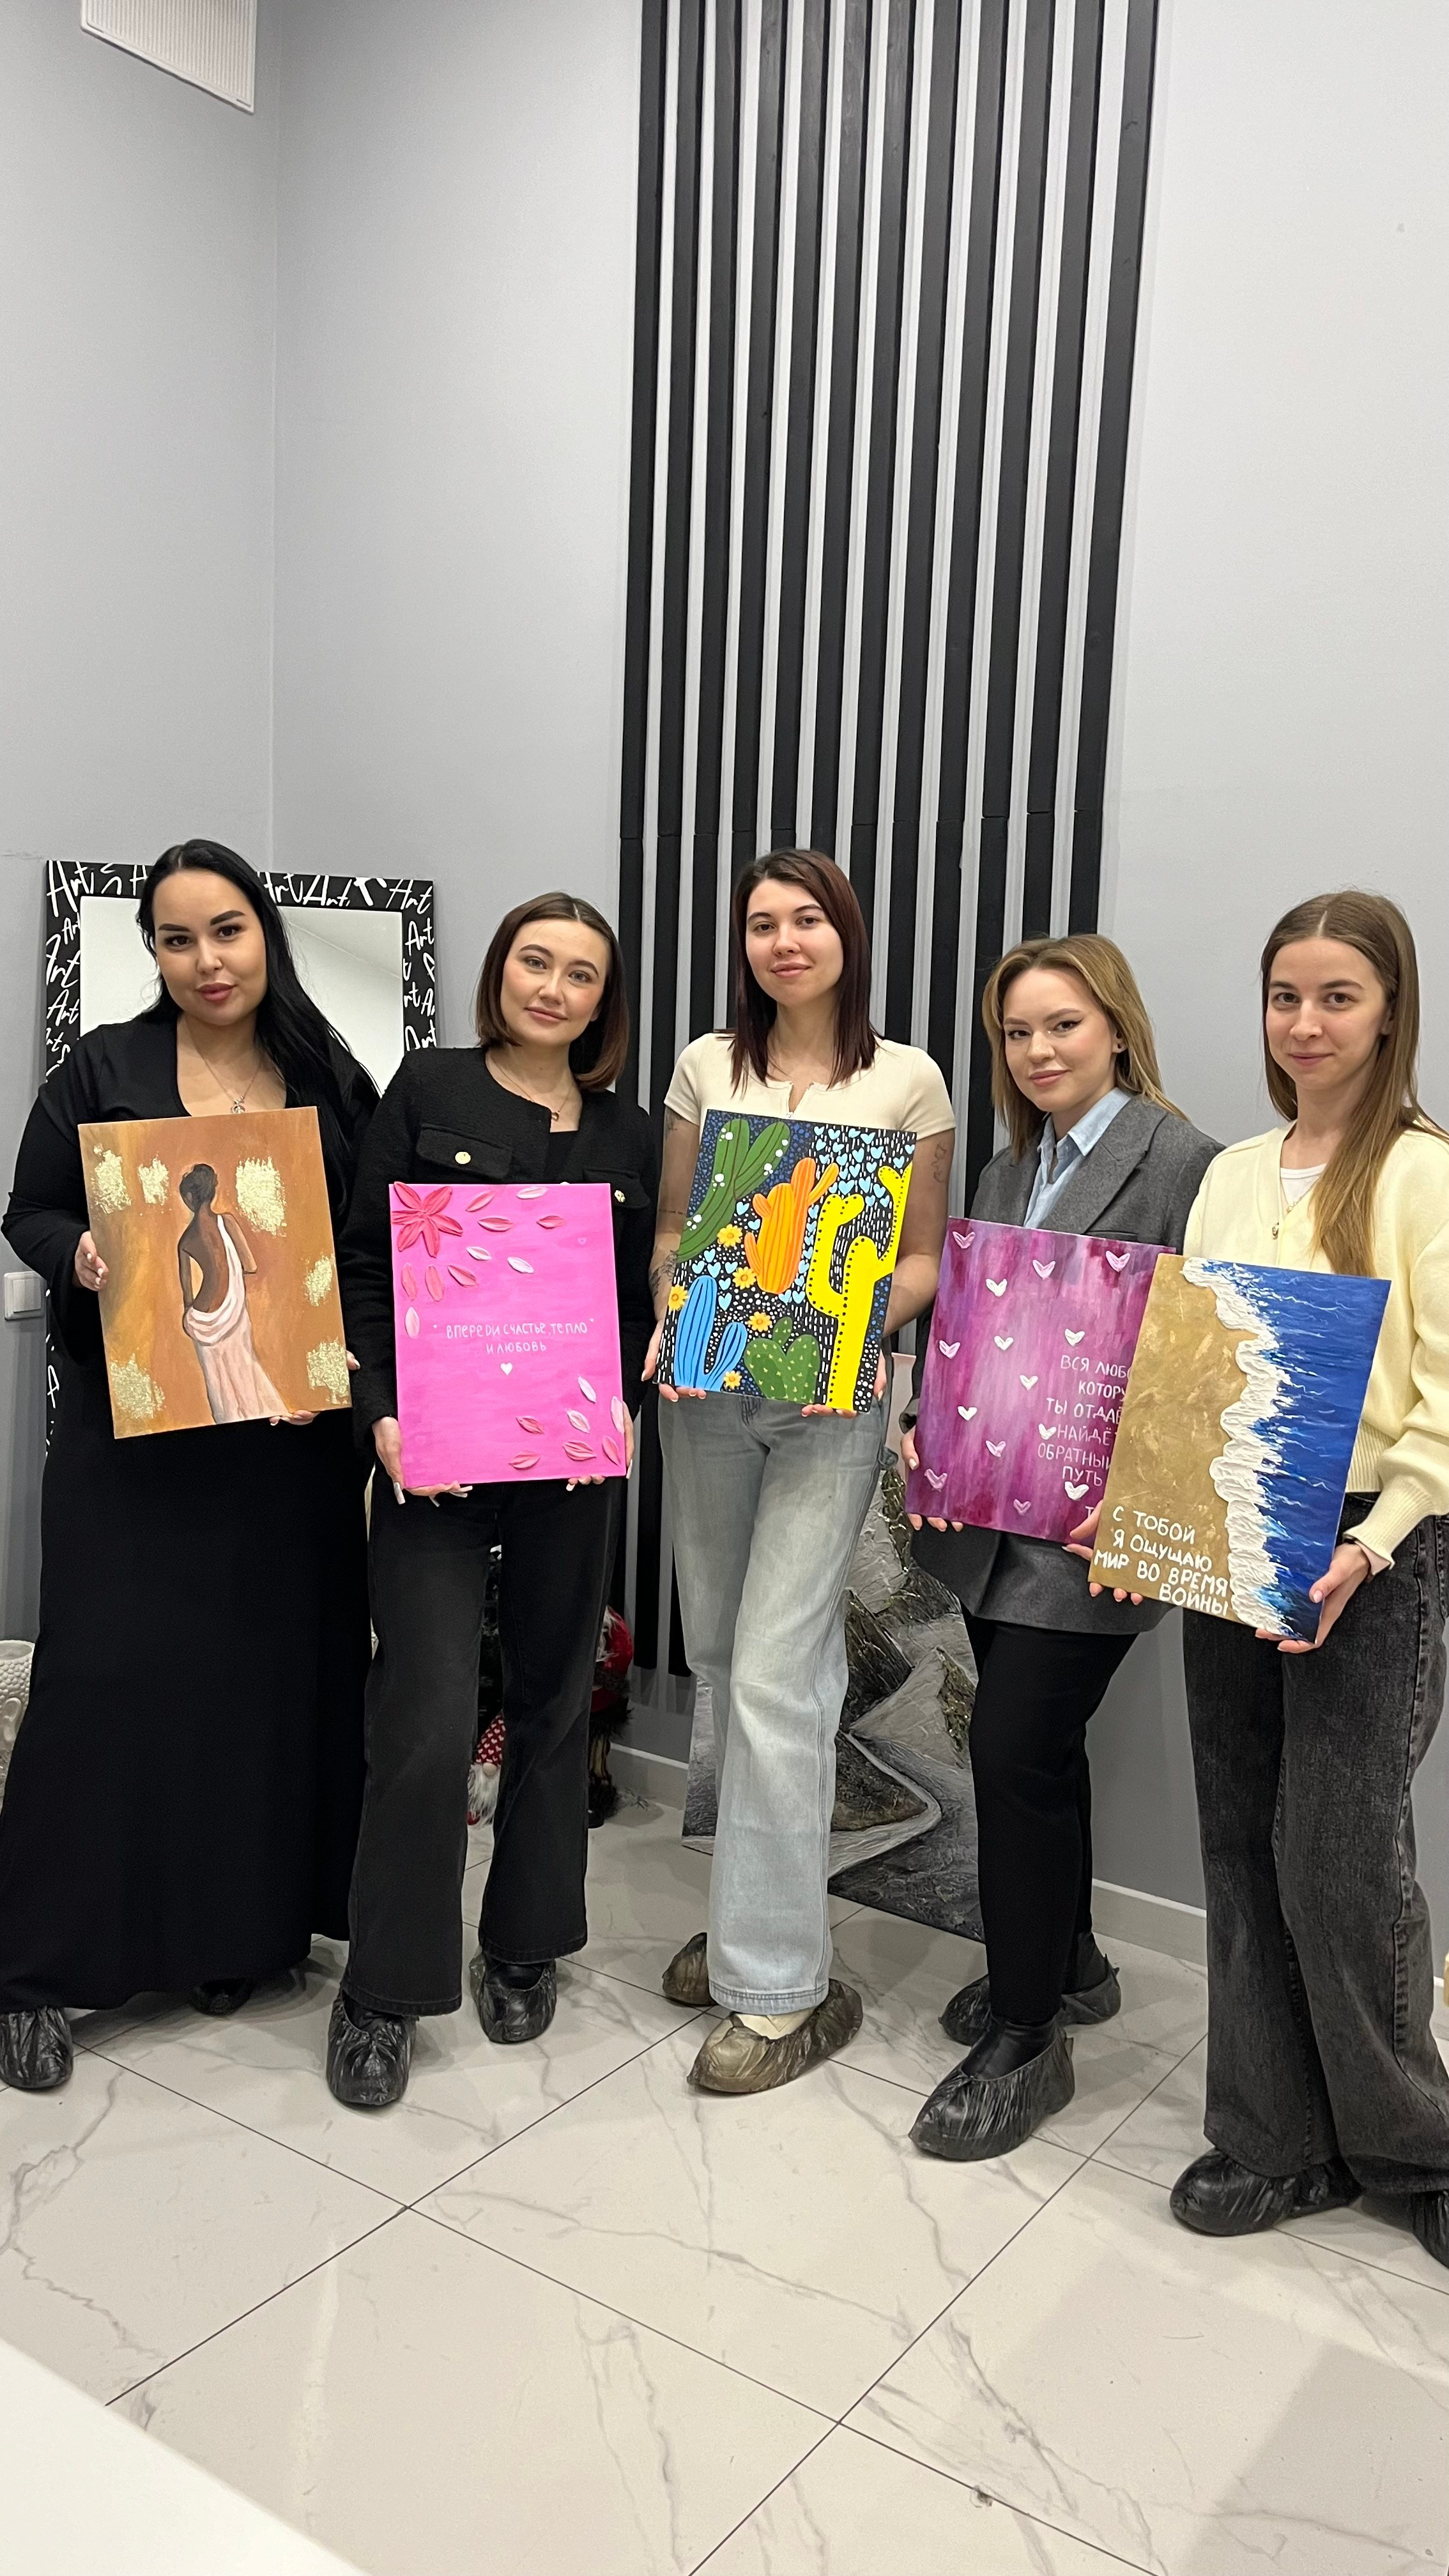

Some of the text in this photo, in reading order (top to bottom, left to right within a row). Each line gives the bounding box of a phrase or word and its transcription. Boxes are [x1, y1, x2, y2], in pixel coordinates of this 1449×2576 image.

[386, 878, 433, 914] Art
[404, 917, 434, 956] Art
[46, 988, 80, 1027] Art
[486, 1340, 547, 1355] И ЛЮБОВЬ
[1060, 1354, 1090, 1372] ВСЯ
[1046, 1397, 1068, 1414] ТЫ
[1057, 1423, 1118, 1446] НАЙДЁ
[1062, 1466, 1103, 1487] ПУТЬ
[1112, 1505, 1196, 1545] С ТОБОЙ
[1113, 1529, 1213, 1572] Я ОЩУЩАЮ
[1094, 1549, 1229, 1597] МИР ВО ВРЕМЯ
[1159, 1583, 1229, 1616] ВОЙНЫ
